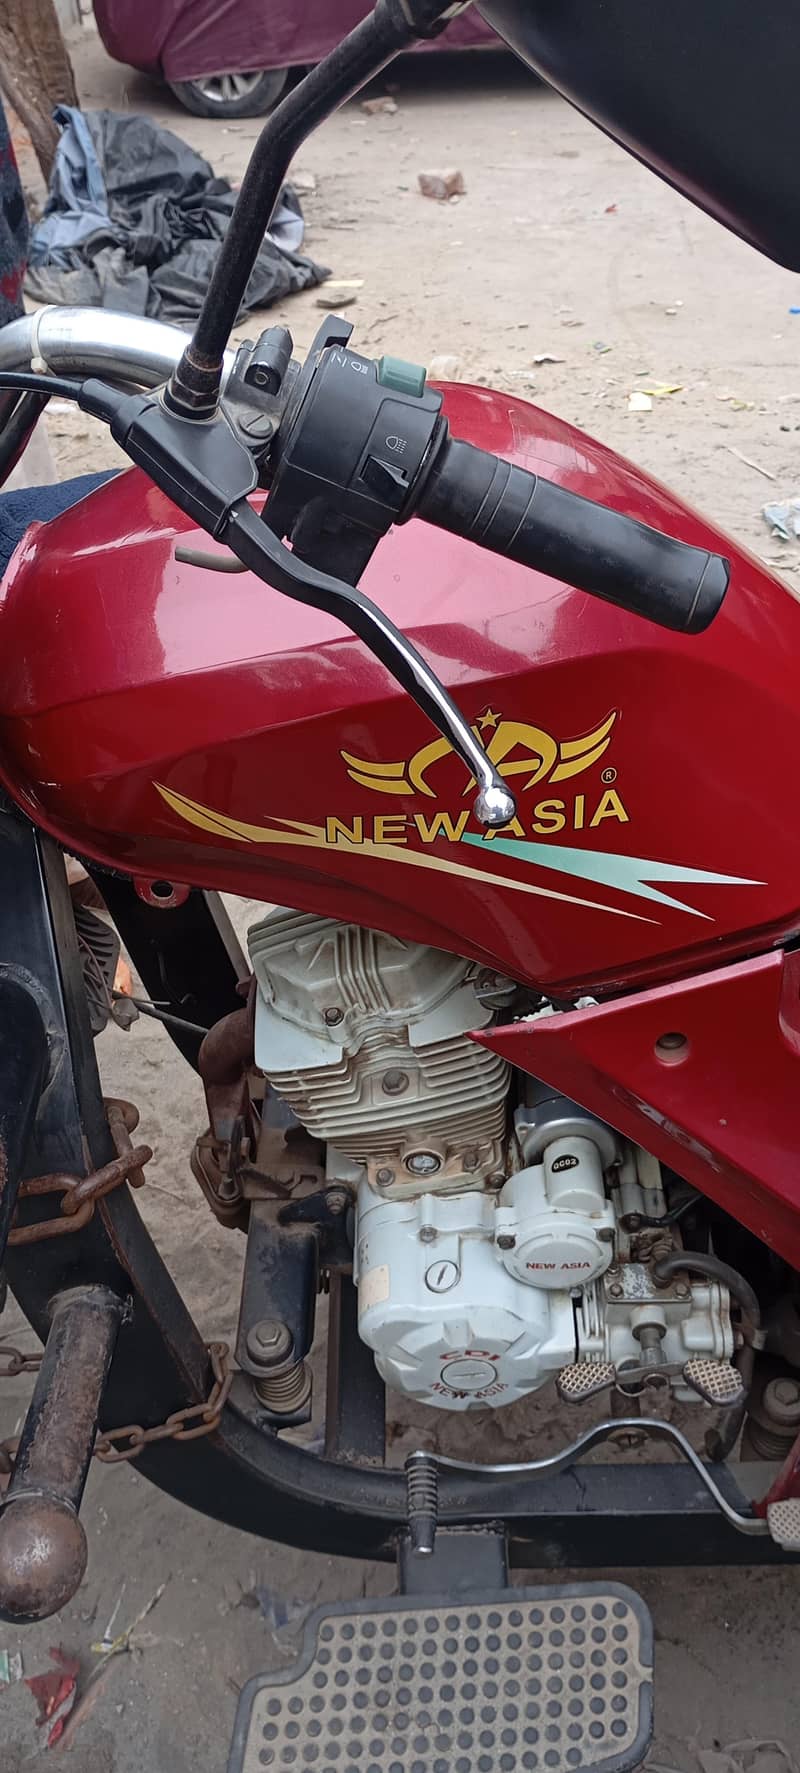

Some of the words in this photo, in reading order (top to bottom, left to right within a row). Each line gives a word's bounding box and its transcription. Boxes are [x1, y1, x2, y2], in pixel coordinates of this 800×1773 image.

[326, 810, 470, 843] NEW
[527, 1262, 556, 1270] NEW
[560, 1262, 591, 1270] ASIA
[439, 1350, 501, 1361] CDI
[430, 1382, 470, 1399] NEW
[474, 1382, 509, 1399] ASIA
